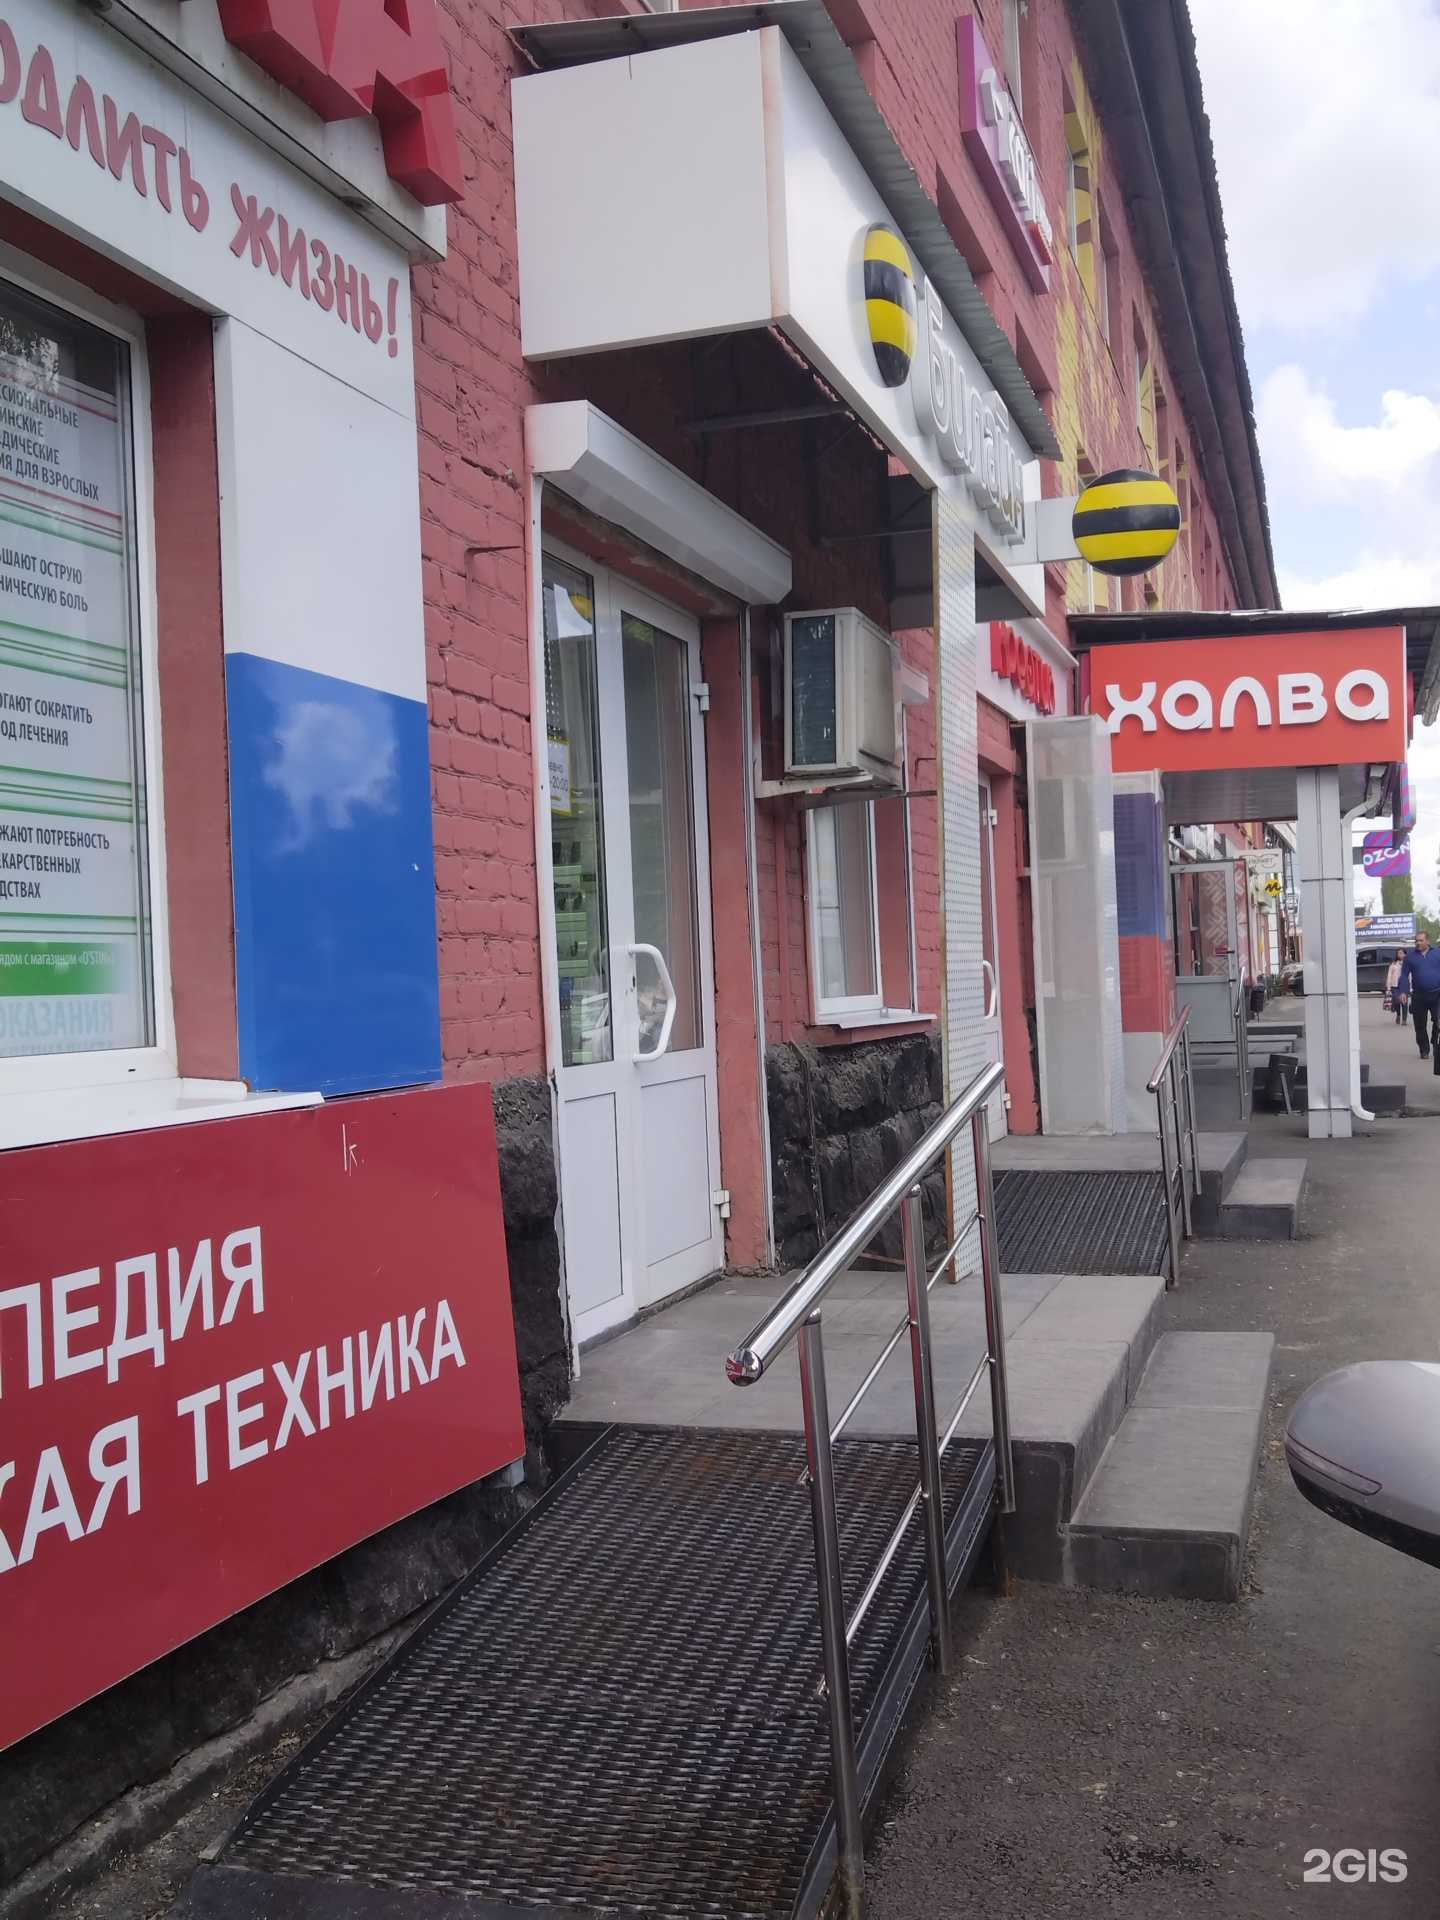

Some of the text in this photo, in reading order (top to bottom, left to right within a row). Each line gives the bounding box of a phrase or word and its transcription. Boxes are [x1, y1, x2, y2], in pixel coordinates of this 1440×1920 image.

[229, 182, 399, 358] ЖИЗНЬ!
[0, 384, 80, 428] СИОНАЛЬНЫЕ
[0, 430, 60, 465] ДИЧЕСКИЕ
[16, 458, 39, 479] ДЛЯ
[41, 466, 99, 501] ВЗРОСЛЫХ
[0, 547, 82, 584] ШАЮТ ОСТРУЮ
[60, 590, 88, 612] БОЛЬ
[34, 699, 93, 724] СОКРАТИТЬ
[1, 720, 69, 746] ОД ЛЕЧЕНИЯ
[0, 825, 110, 850] ЖАЮТ ПОТРЕБНОСТЬ
[0, 852, 81, 874] КАРСТВЕННЫХ
[0, 880, 41, 900] ДСТВАХ
[0, 1226, 265, 1399] ПЕДИЯ
[176, 1299, 467, 1485] ТЕХНИКА
